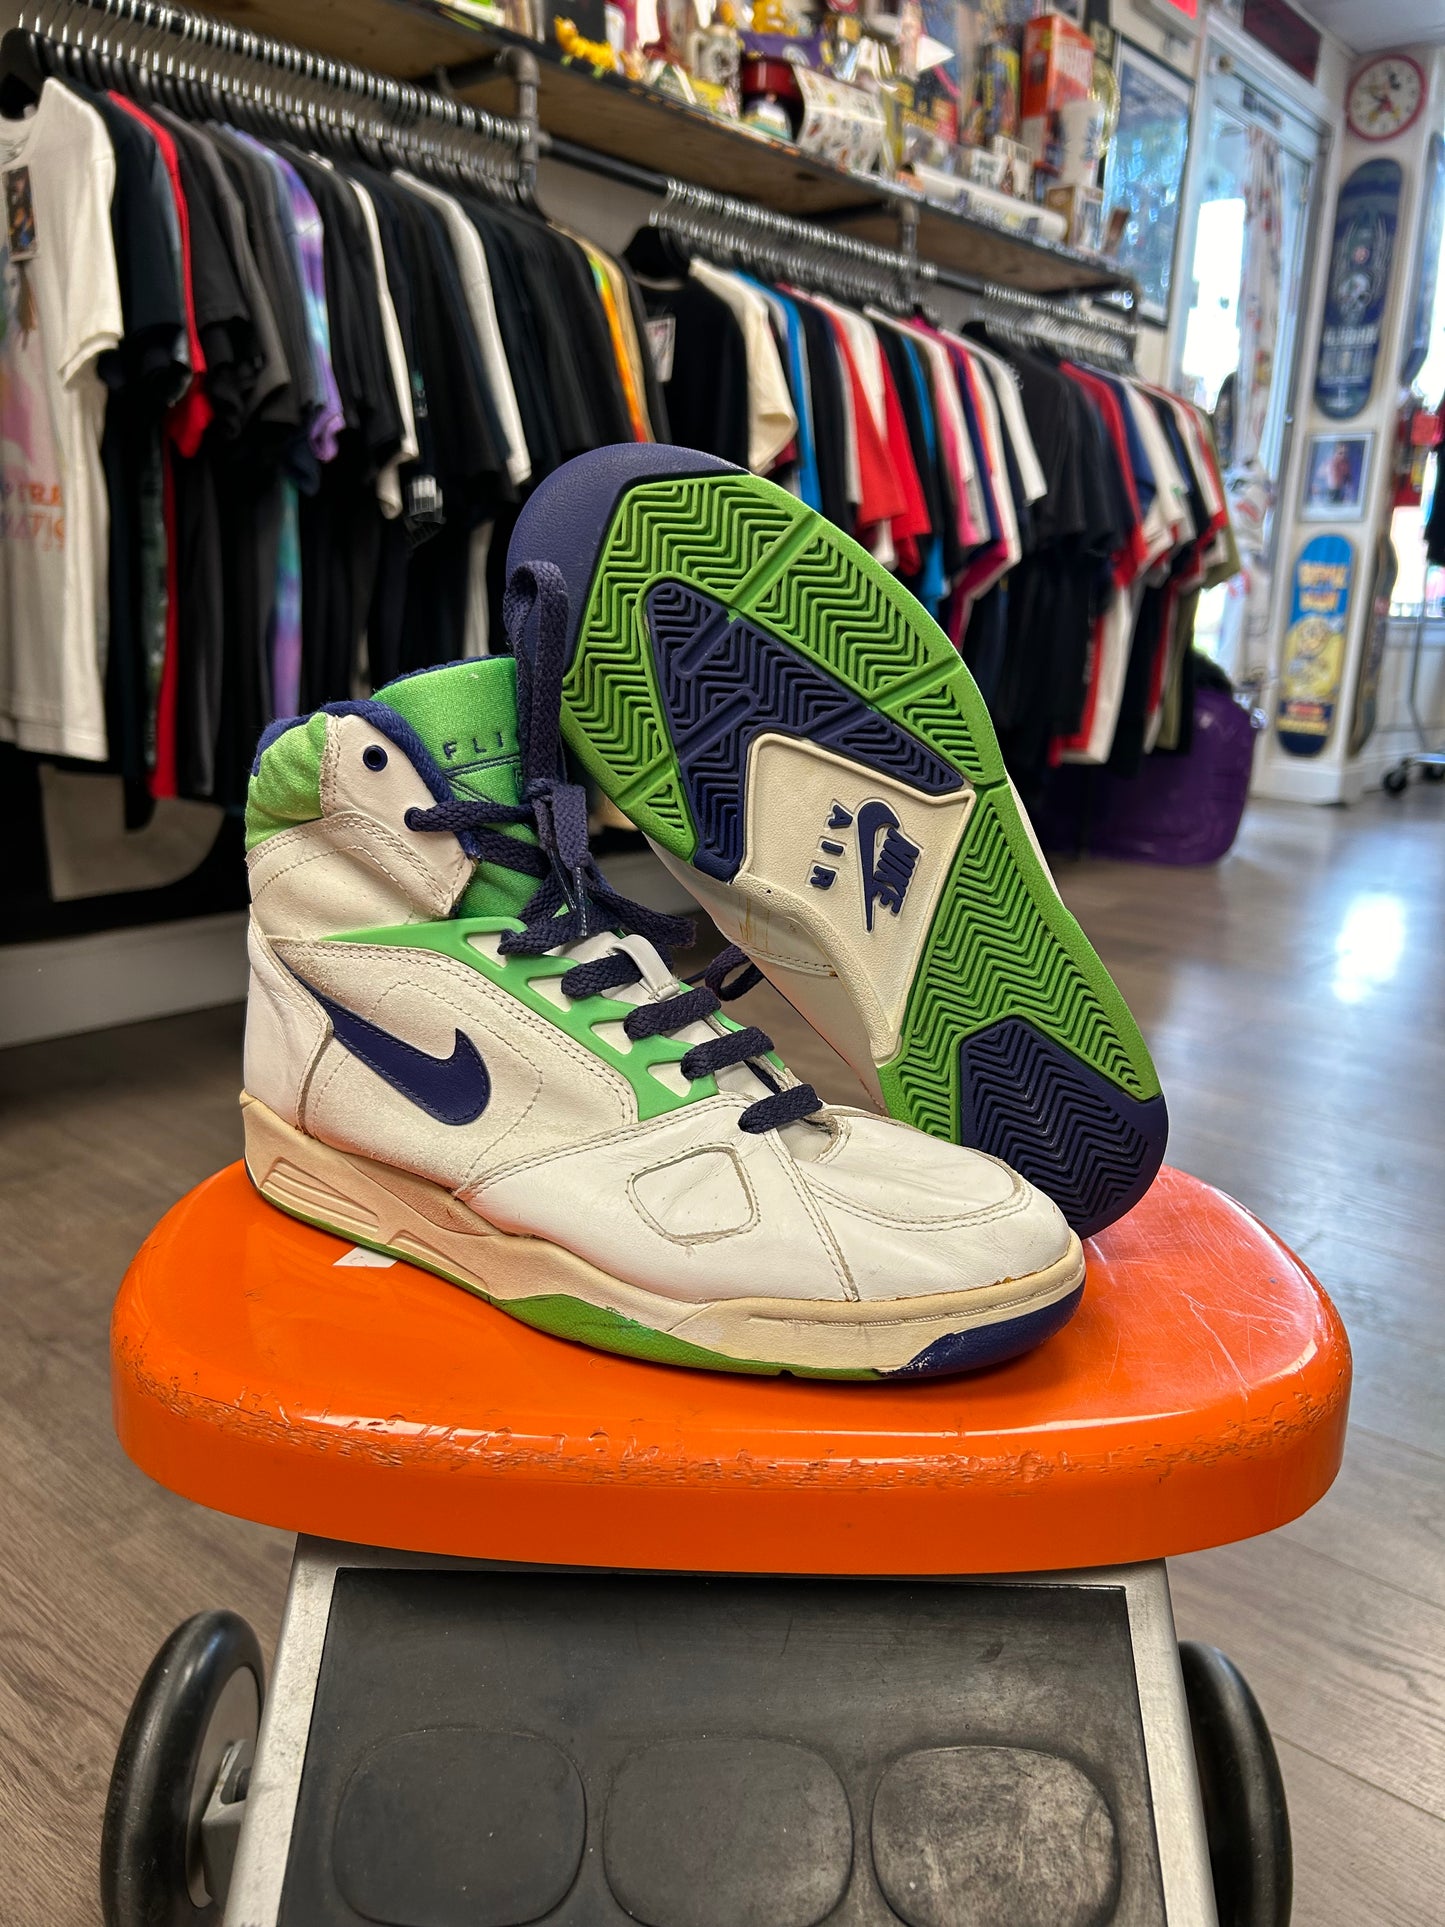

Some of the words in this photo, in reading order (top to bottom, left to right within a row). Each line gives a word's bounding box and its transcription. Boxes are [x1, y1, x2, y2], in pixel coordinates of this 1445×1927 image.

[443, 732, 504, 760] FLI
[810, 803, 854, 891] AIR
[873, 826, 921, 915] NIKE
